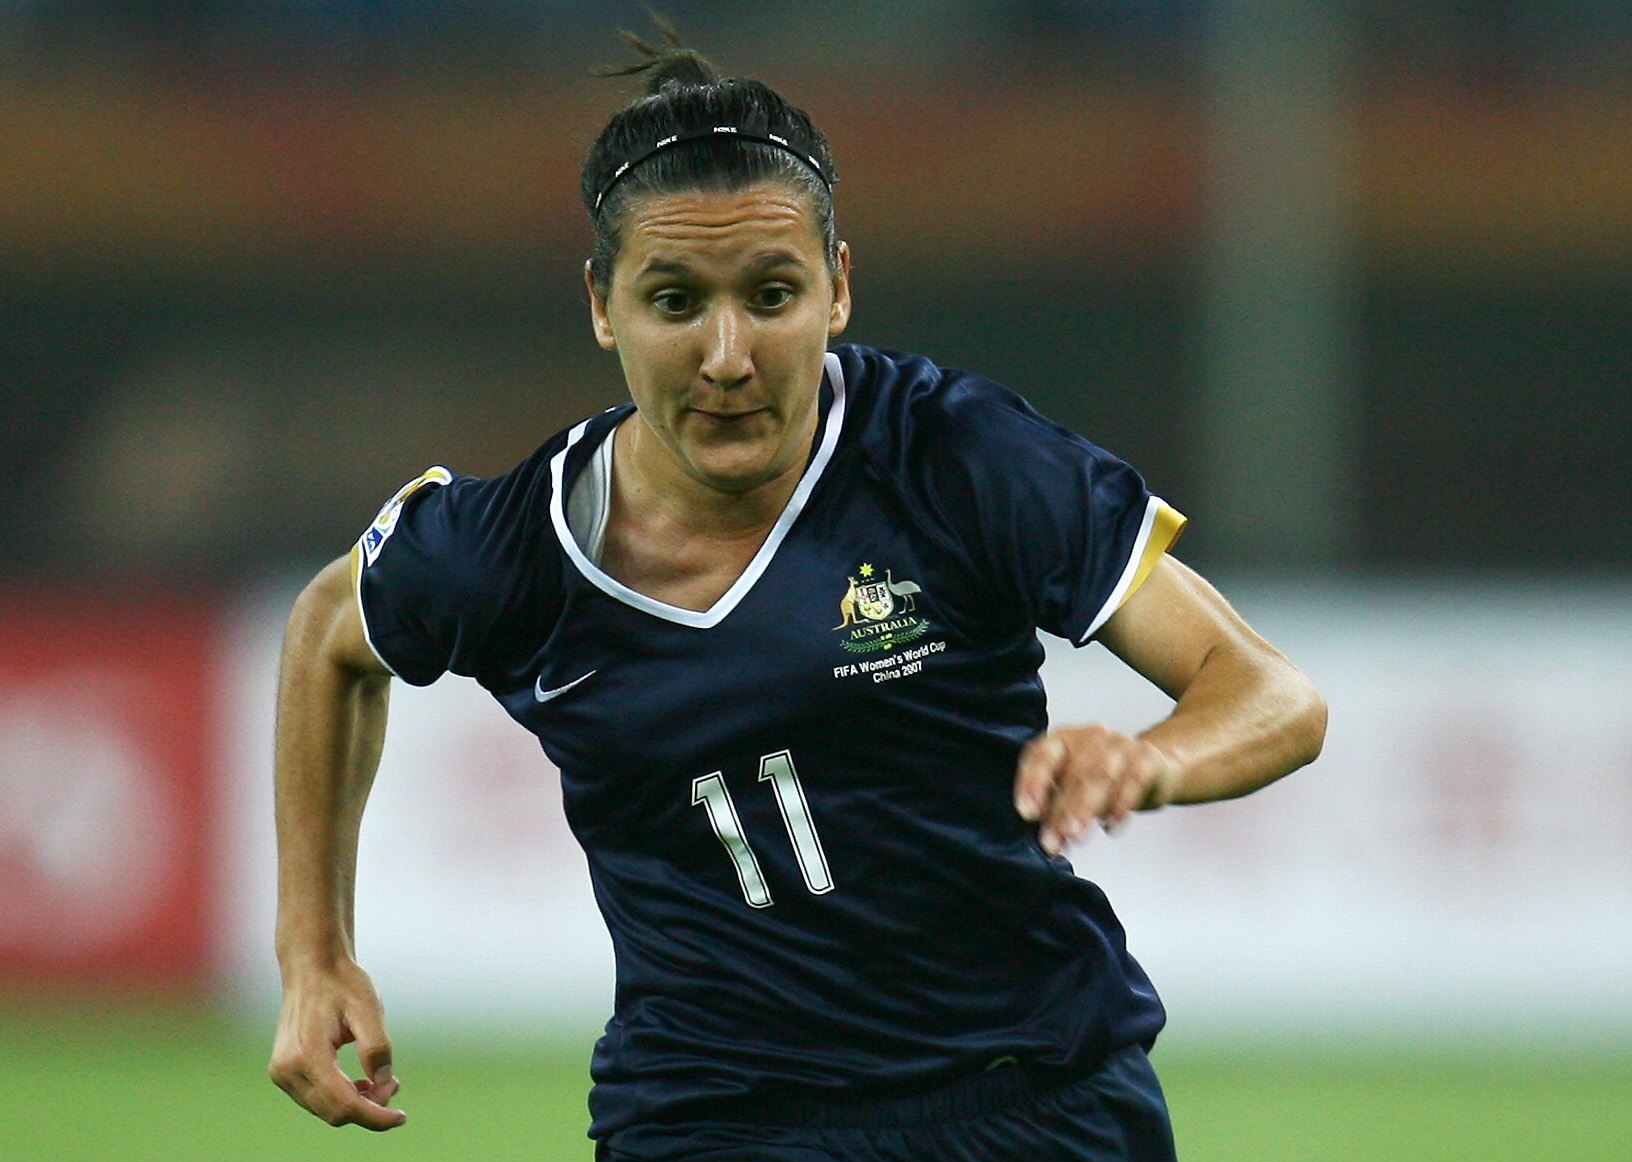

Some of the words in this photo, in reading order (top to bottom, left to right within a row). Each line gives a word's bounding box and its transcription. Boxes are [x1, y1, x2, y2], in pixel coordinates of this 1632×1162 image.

[850, 616, 918, 640] AUSTRALIA
[833, 664, 858, 678] FIFA
[859, 654, 903, 673] Women's
[903, 645, 928, 660] World
[929, 641, 947, 653] Cup
[872, 669, 901, 684] China
[901, 660, 923, 677] 2007
[691, 749, 835, 909] 11
